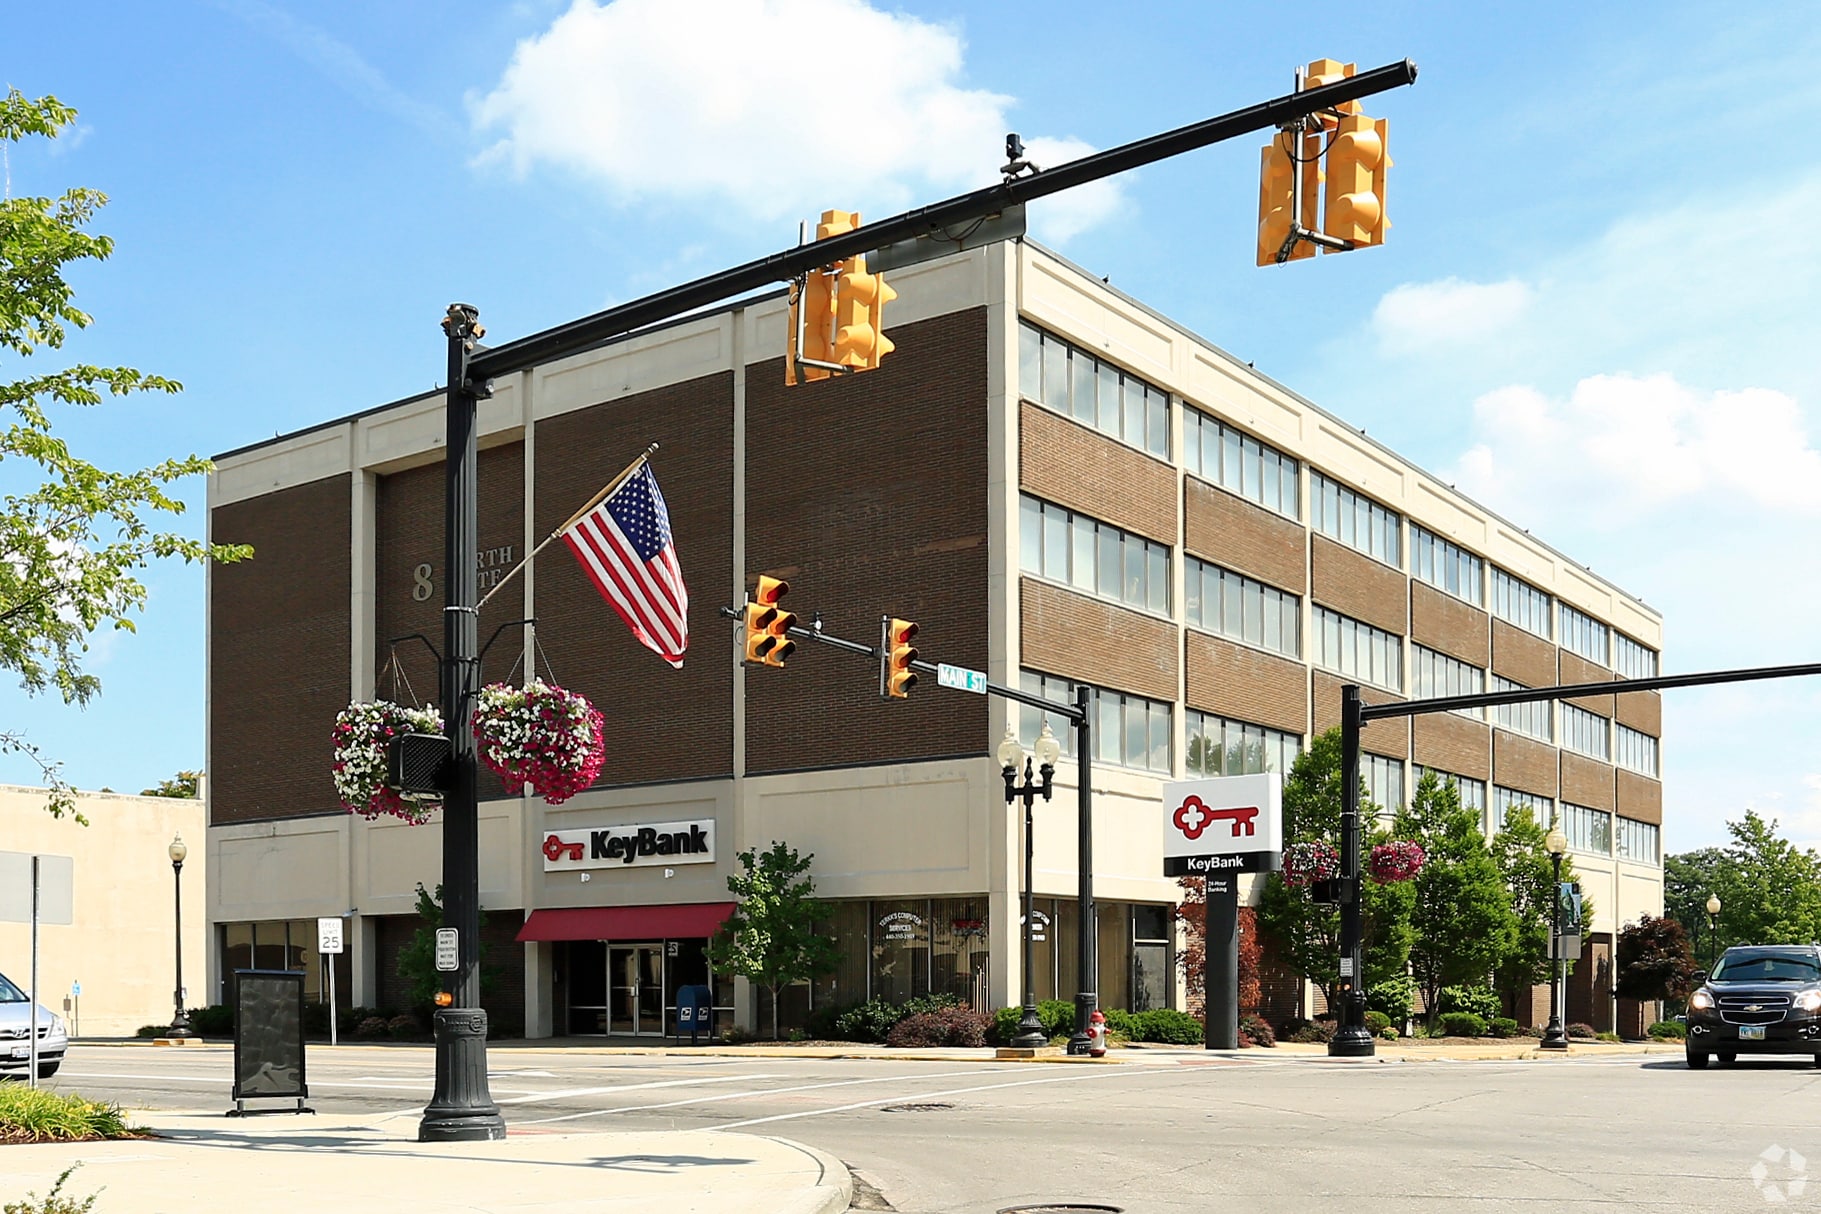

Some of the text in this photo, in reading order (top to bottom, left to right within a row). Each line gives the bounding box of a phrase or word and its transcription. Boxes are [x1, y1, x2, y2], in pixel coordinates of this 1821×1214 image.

[477, 545, 514, 569] RTH
[412, 563, 434, 601] 8
[940, 665, 986, 691] MAIN ST
[590, 824, 709, 864] KeyBank
[1187, 855, 1244, 872] KeyBank
[322, 936, 340, 949] 25
